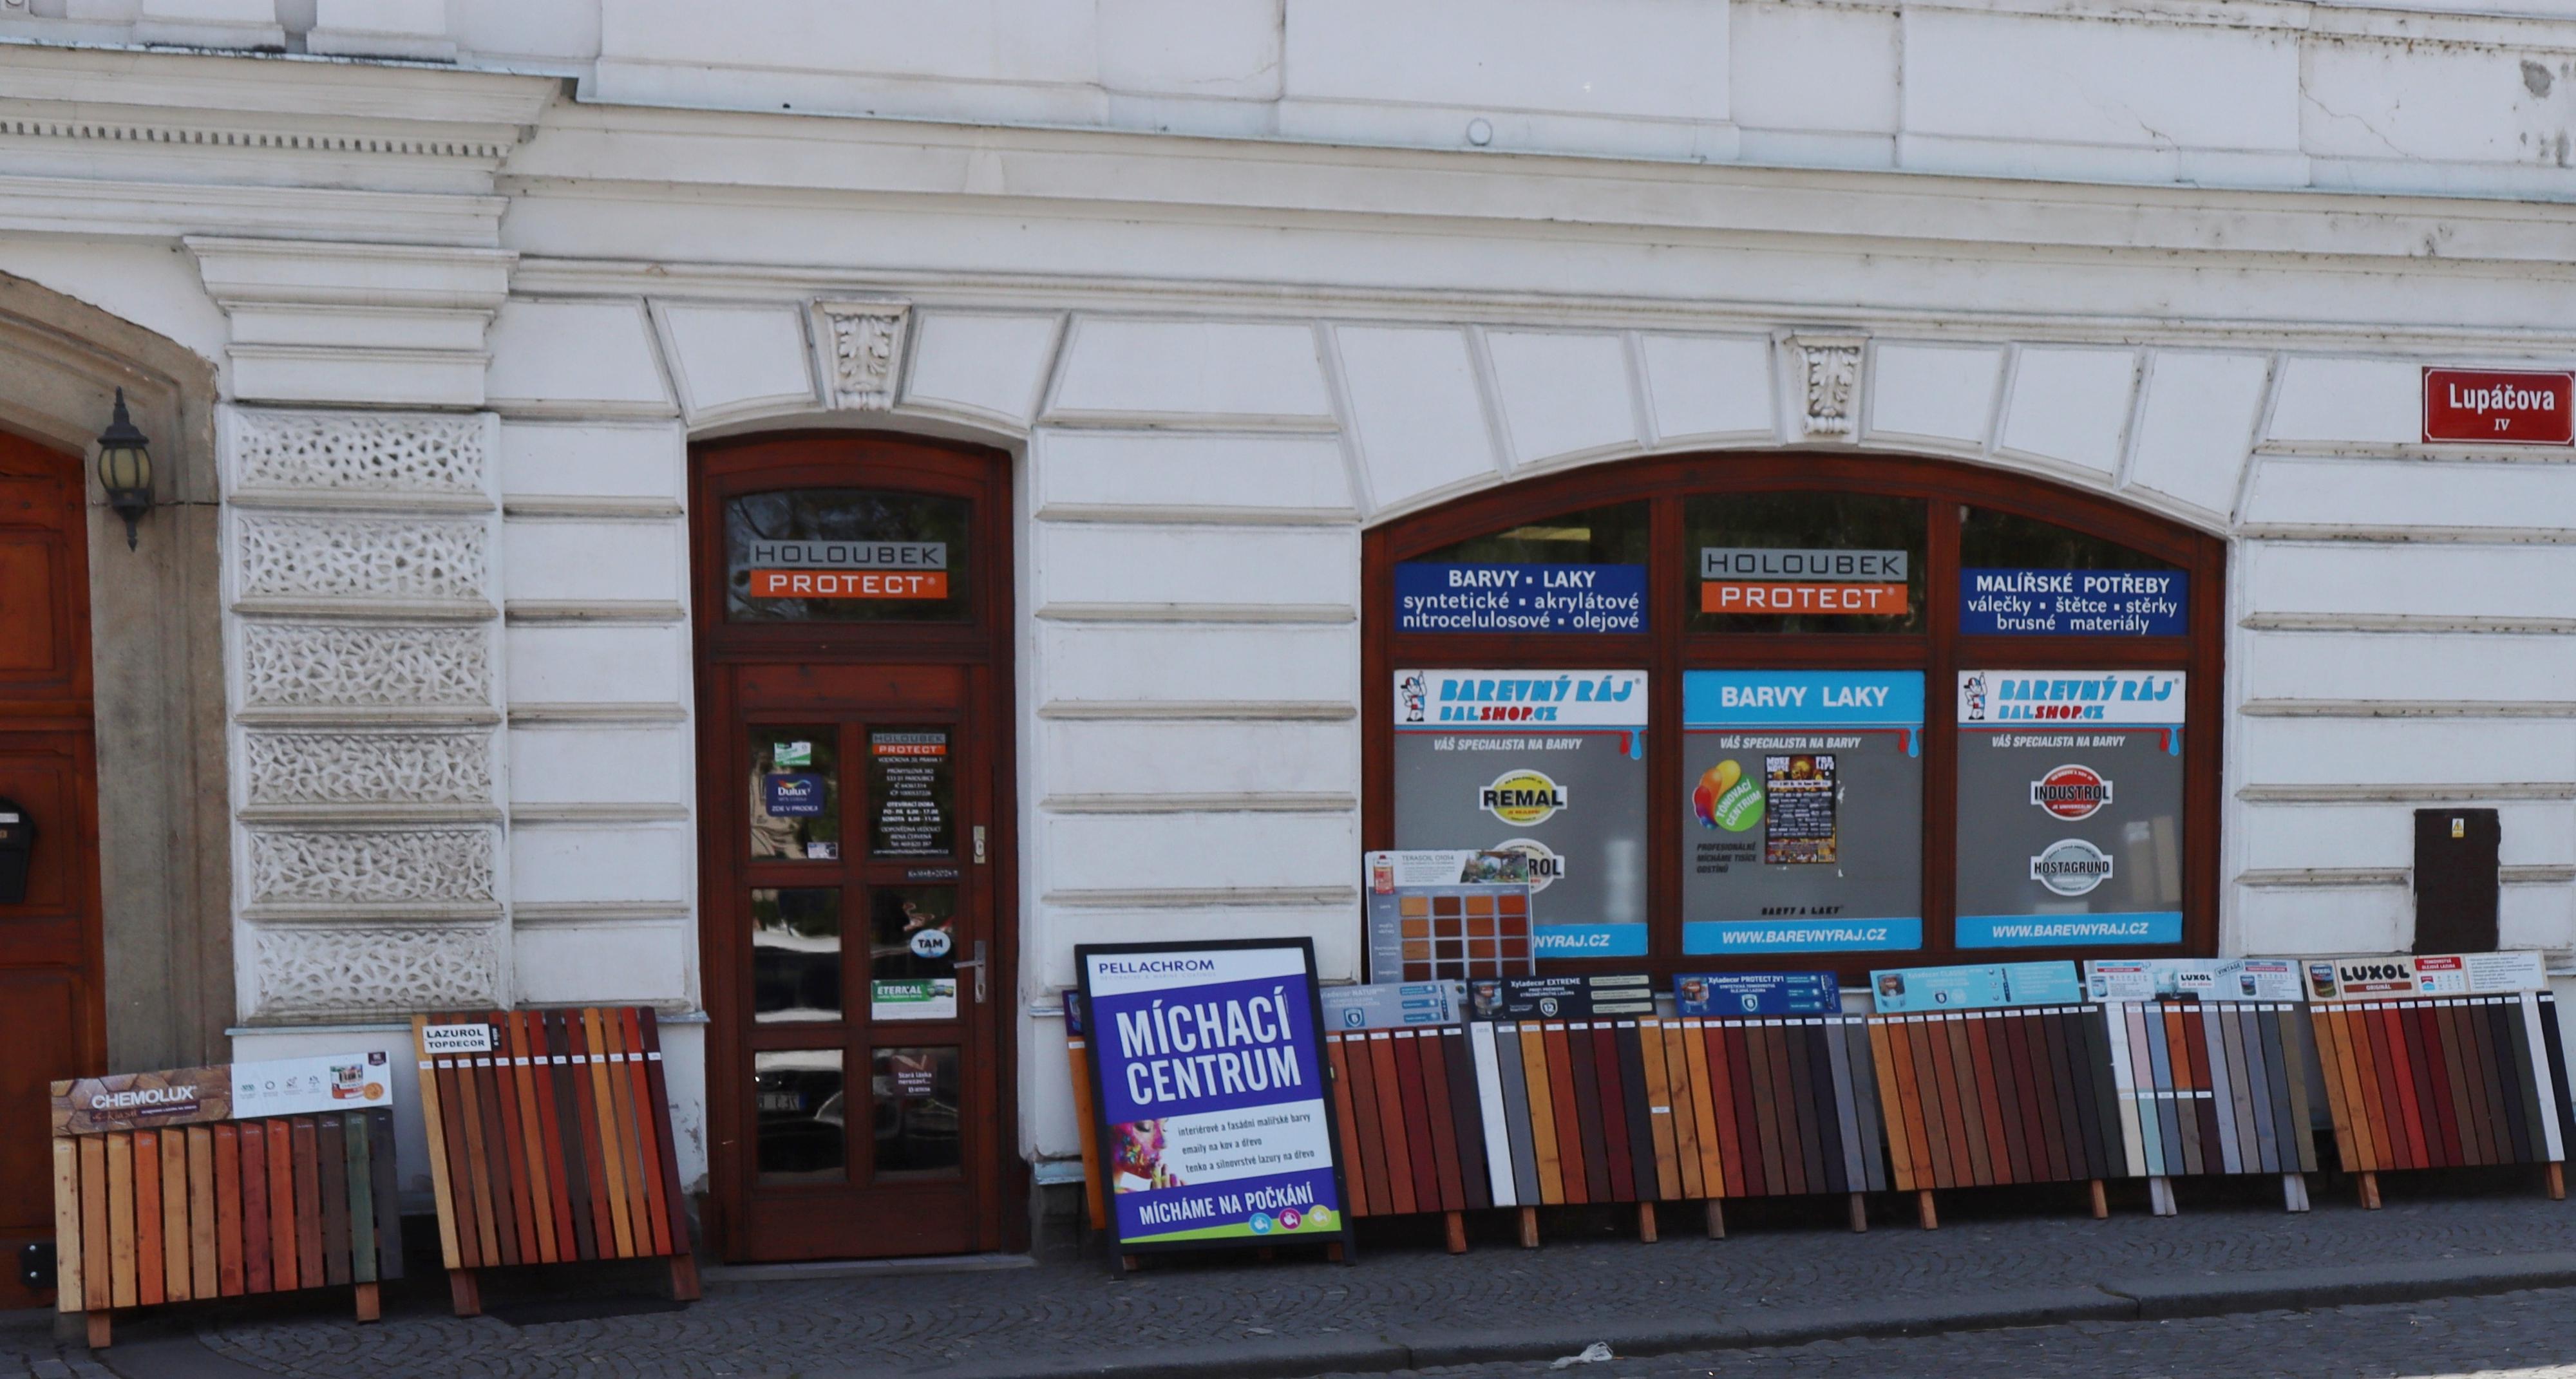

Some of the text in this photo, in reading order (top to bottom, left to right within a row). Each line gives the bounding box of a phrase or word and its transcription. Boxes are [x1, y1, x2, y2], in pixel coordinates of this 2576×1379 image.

[2449, 382, 2555, 414] Lupáčova
[2494, 418, 2510, 431] IV
[755, 545, 938, 564] HOLOUBEK
[1708, 553, 1900, 575] HOLOUBEK
[769, 575, 923, 594] PROTECT
[1449, 570, 1596, 588] BARVY LAKY
[1976, 572, 2170, 594] MALÍŘSKÉ POTŘEBY
[1403, 592, 1639, 614] syntetické akrylátové
[1721, 586, 1883, 608] PROTECT
[1968, 596, 2177, 617] válečky štětce stěrky
[1403, 611, 1639, 632] nitrocelulosové olejové
[1997, 614, 2149, 635] brusné materiály
[1439, 675, 1633, 702] BAREVNÝ RÁJ
[1998, 675, 2173, 701] BAREVNÝ RÁJ
[1721, 686, 1889, 708] BARVY LAKY
[1439, 706, 1558, 721] BALSHOP.CZ
[1998, 705, 2105, 719] BALSHOP.CZ
[1434, 736, 1582, 751] VÁŠ SPECIALISTA NA BARVY
[1720, 735, 1861, 749] VÁŠ SPECIALISTA NA BARVY
[1992, 734, 2125, 747] VÁŠ SPECIALISTA NA BARVY
[879, 745, 937, 754] PROTECT
[778, 787, 806, 796] Dulux
[1483, 790, 1564, 807] REMAL
[2034, 785, 2109, 800] INDUSTROL
[1726, 790, 1762, 827] CENTRUM
[2034, 861, 2109, 874] HOSTAGRUND
[1761, 906, 1796, 915] BARVY
[1811, 906, 1840, 915] LAKY
[1722, 928, 1887, 944] WWW.BAREVNYRAJ.CZ
[1993, 923, 2149, 938] WWW.BAREVNYRAJ.CZ
[918, 939, 943, 948] TAM
[1098, 959, 1215, 974] PELLACHROM
[2217, 962, 2241, 975] VINTAGE
[2340, 964, 2410, 981] LUXOL
[1511, 977, 1580, 988] Xyladecor EXTREME
[1709, 977, 1739, 985] Xyladecor
[2181, 973, 2212, 982] LUXOL
[876, 986, 922, 995] ETERNAL
[1544, 1004, 1555, 1013] 12
[1116, 985, 1293, 1058] MÍCHACÍ
[426, 1028, 484, 1038] LAZUROL
[428, 1039, 485, 1049] TOPDECOR
[1126, 1045, 1302, 1106] CENTRUM
[91, 1085, 194, 1109] CHEMOLUX
[1178, 1122, 1219, 1137] interiérové
[1227, 1117, 1255, 1131] fasádní
[1257, 1113, 1289, 1129] malířské
[1291, 1112, 1311, 1125] barvy
[1182, 1143, 1207, 1155] emaily
[1220, 1140, 1233, 1150] kov
[1242, 1138, 1262, 1148] dřevo
[1186, 1162, 1207, 1173] tenko
[1216, 1154, 1256, 1170] silnovrstvé
[1258, 1154, 1282, 1166] lazury
[1294, 1149, 1314, 1159] dřevo
[1139, 1181, 1314, 1225] MÍCHÁME NA POČKÁNÍ
